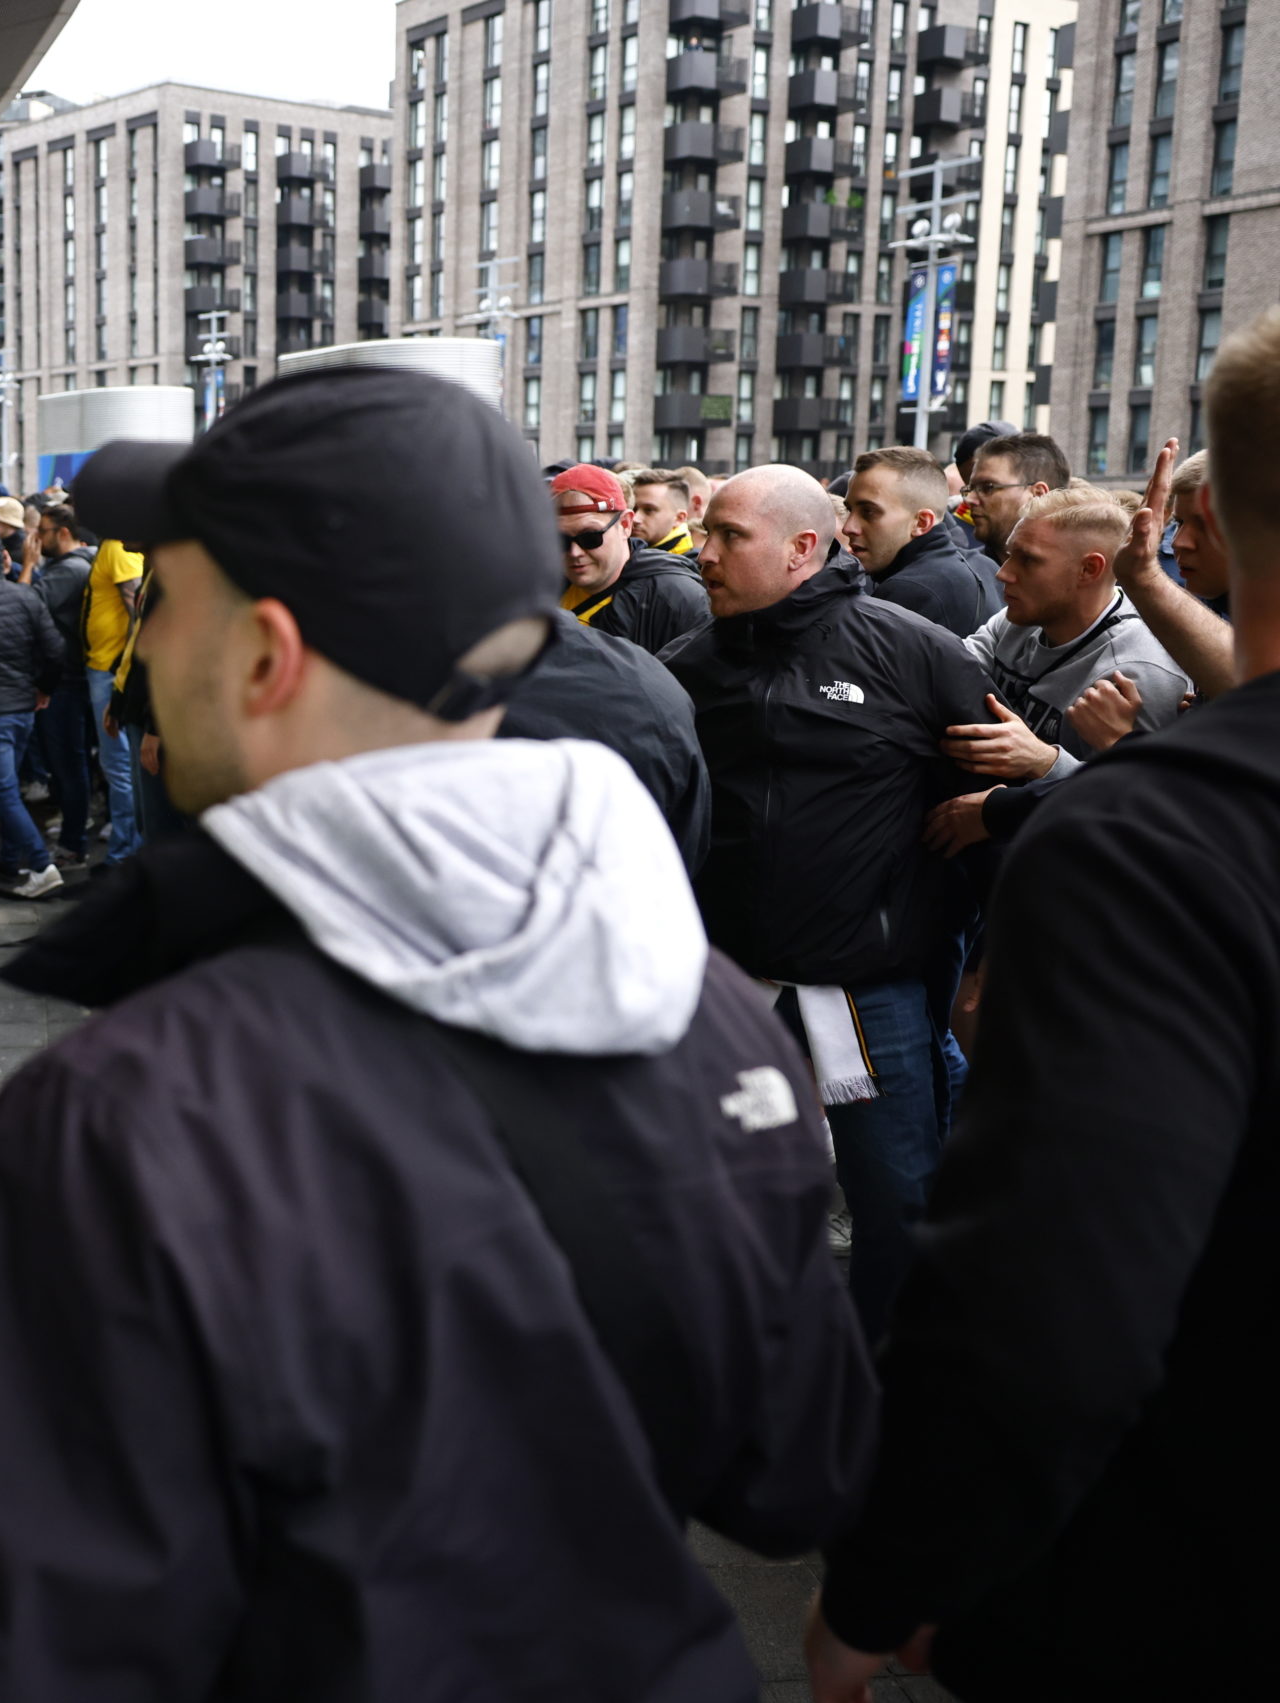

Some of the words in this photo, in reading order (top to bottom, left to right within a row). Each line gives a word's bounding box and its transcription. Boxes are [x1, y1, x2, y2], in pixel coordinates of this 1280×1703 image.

[833, 680, 850, 689] THE
[819, 685, 849, 695] NORTH
[826, 692, 849, 701] FACE
